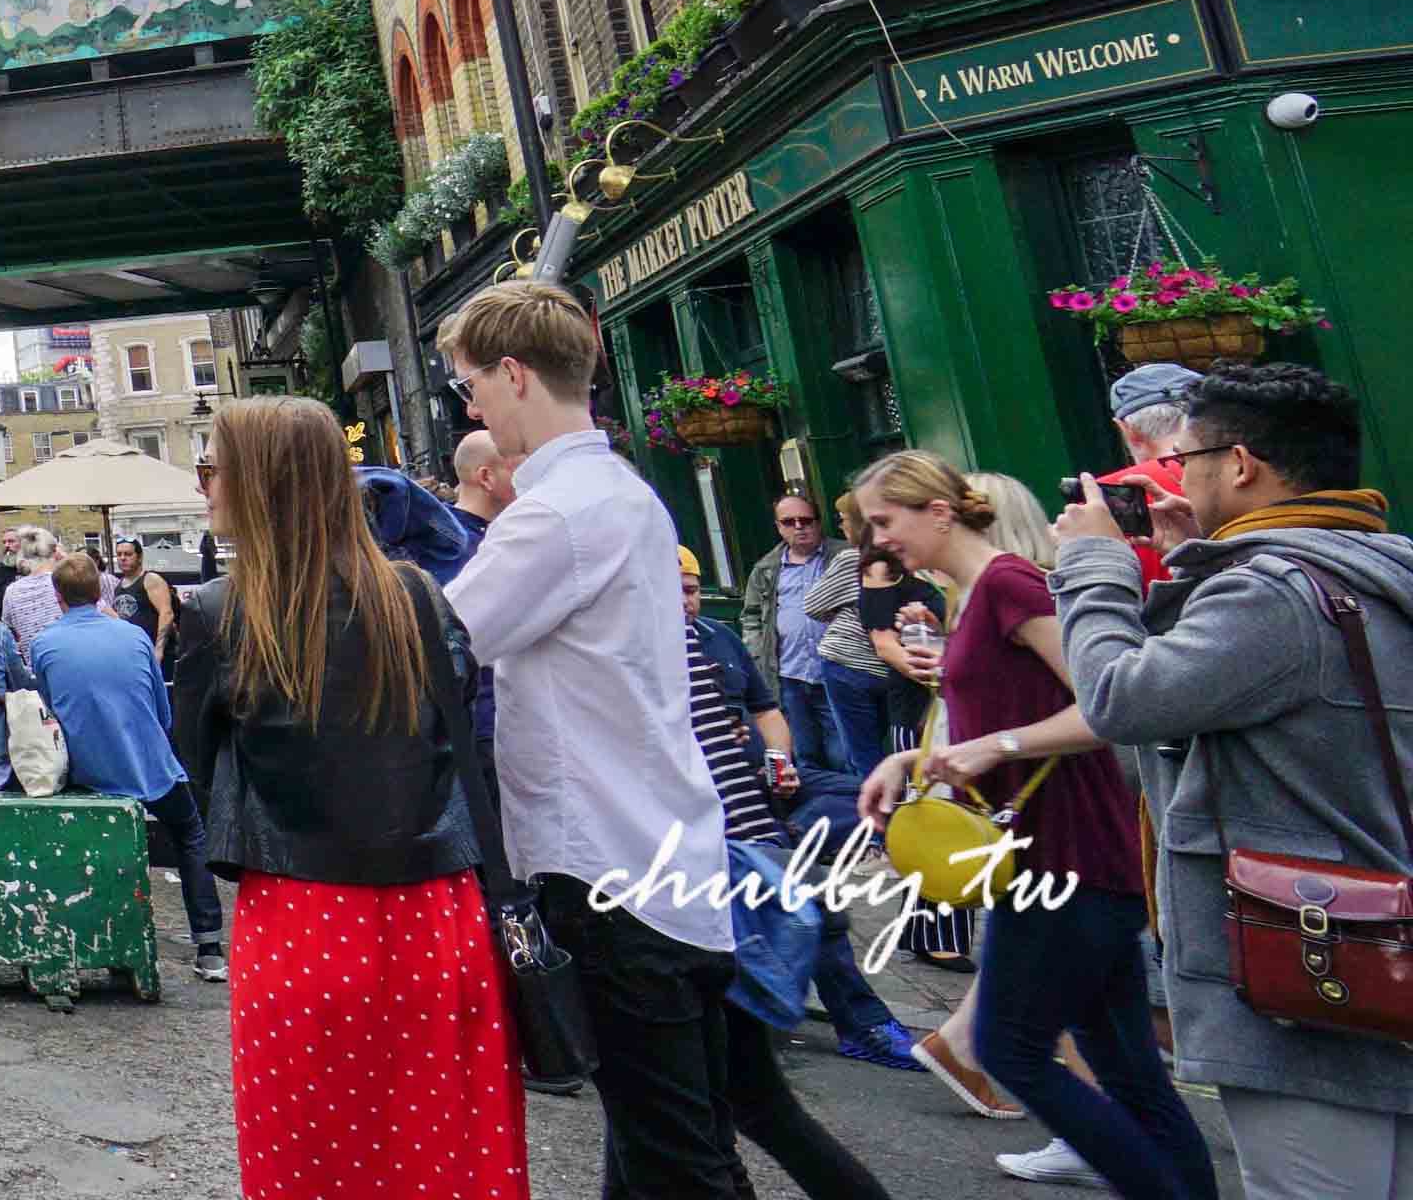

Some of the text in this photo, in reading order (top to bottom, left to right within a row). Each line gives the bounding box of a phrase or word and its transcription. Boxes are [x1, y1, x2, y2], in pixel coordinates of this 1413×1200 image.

[938, 32, 1160, 103] A WARM WELCOME
[597, 169, 758, 302] THE MARKET PORTER
